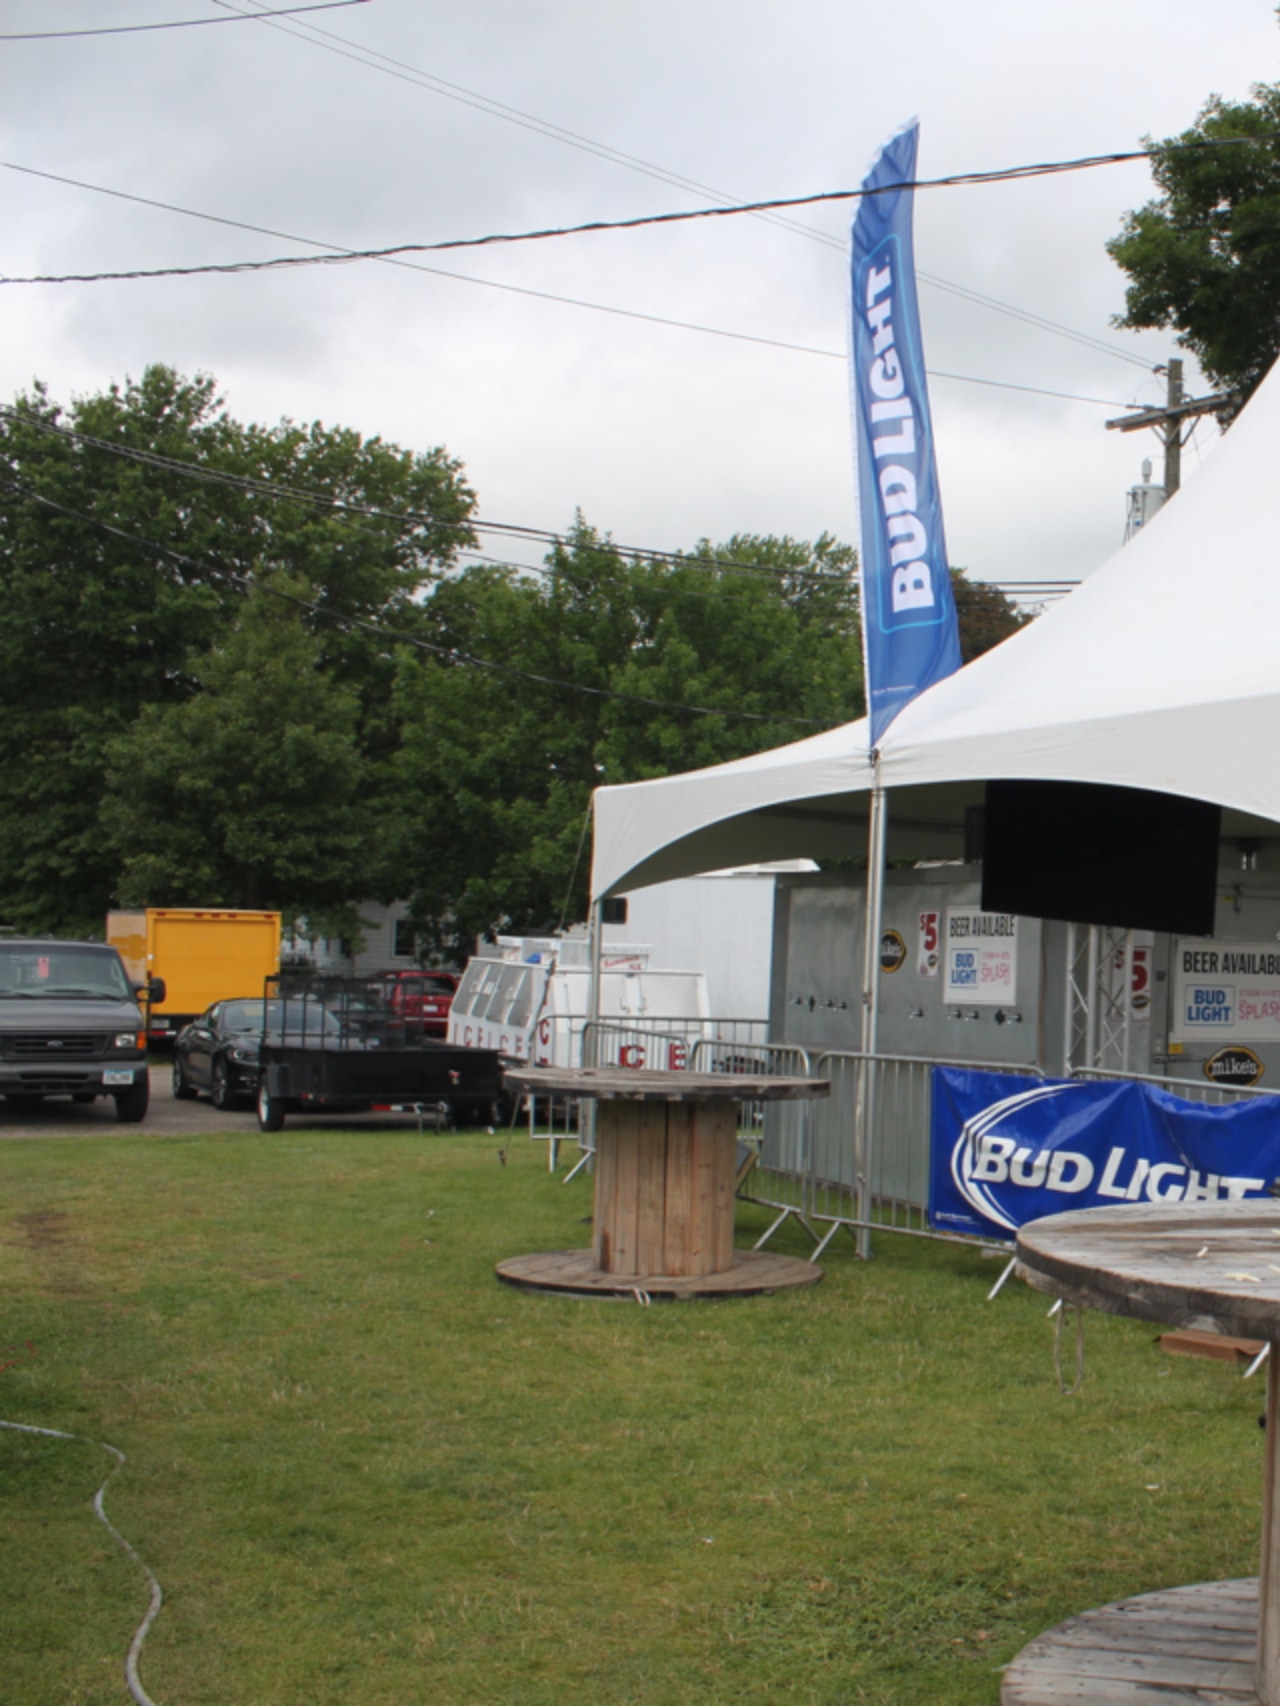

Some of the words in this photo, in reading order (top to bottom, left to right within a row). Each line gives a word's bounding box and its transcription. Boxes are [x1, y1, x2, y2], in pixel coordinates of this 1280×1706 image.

[864, 264, 916, 459] LIGHT
[880, 463, 935, 616] BUD
[919, 913, 938, 951] $5
[950, 916, 971, 938] BEER
[972, 915, 1015, 938] AVAILABLE
[955, 952, 975, 968] BUD
[1183, 950, 1219, 974] BEER
[951, 969, 978, 985] LIGHT
[1193, 989, 1227, 1005] BUD
[1187, 1005, 1232, 1022] LIGHT
[1211, 1057, 1257, 1075] mike's
[971, 1135, 1095, 1194] BUD
[1097, 1146, 1266, 1203] LIGHT
